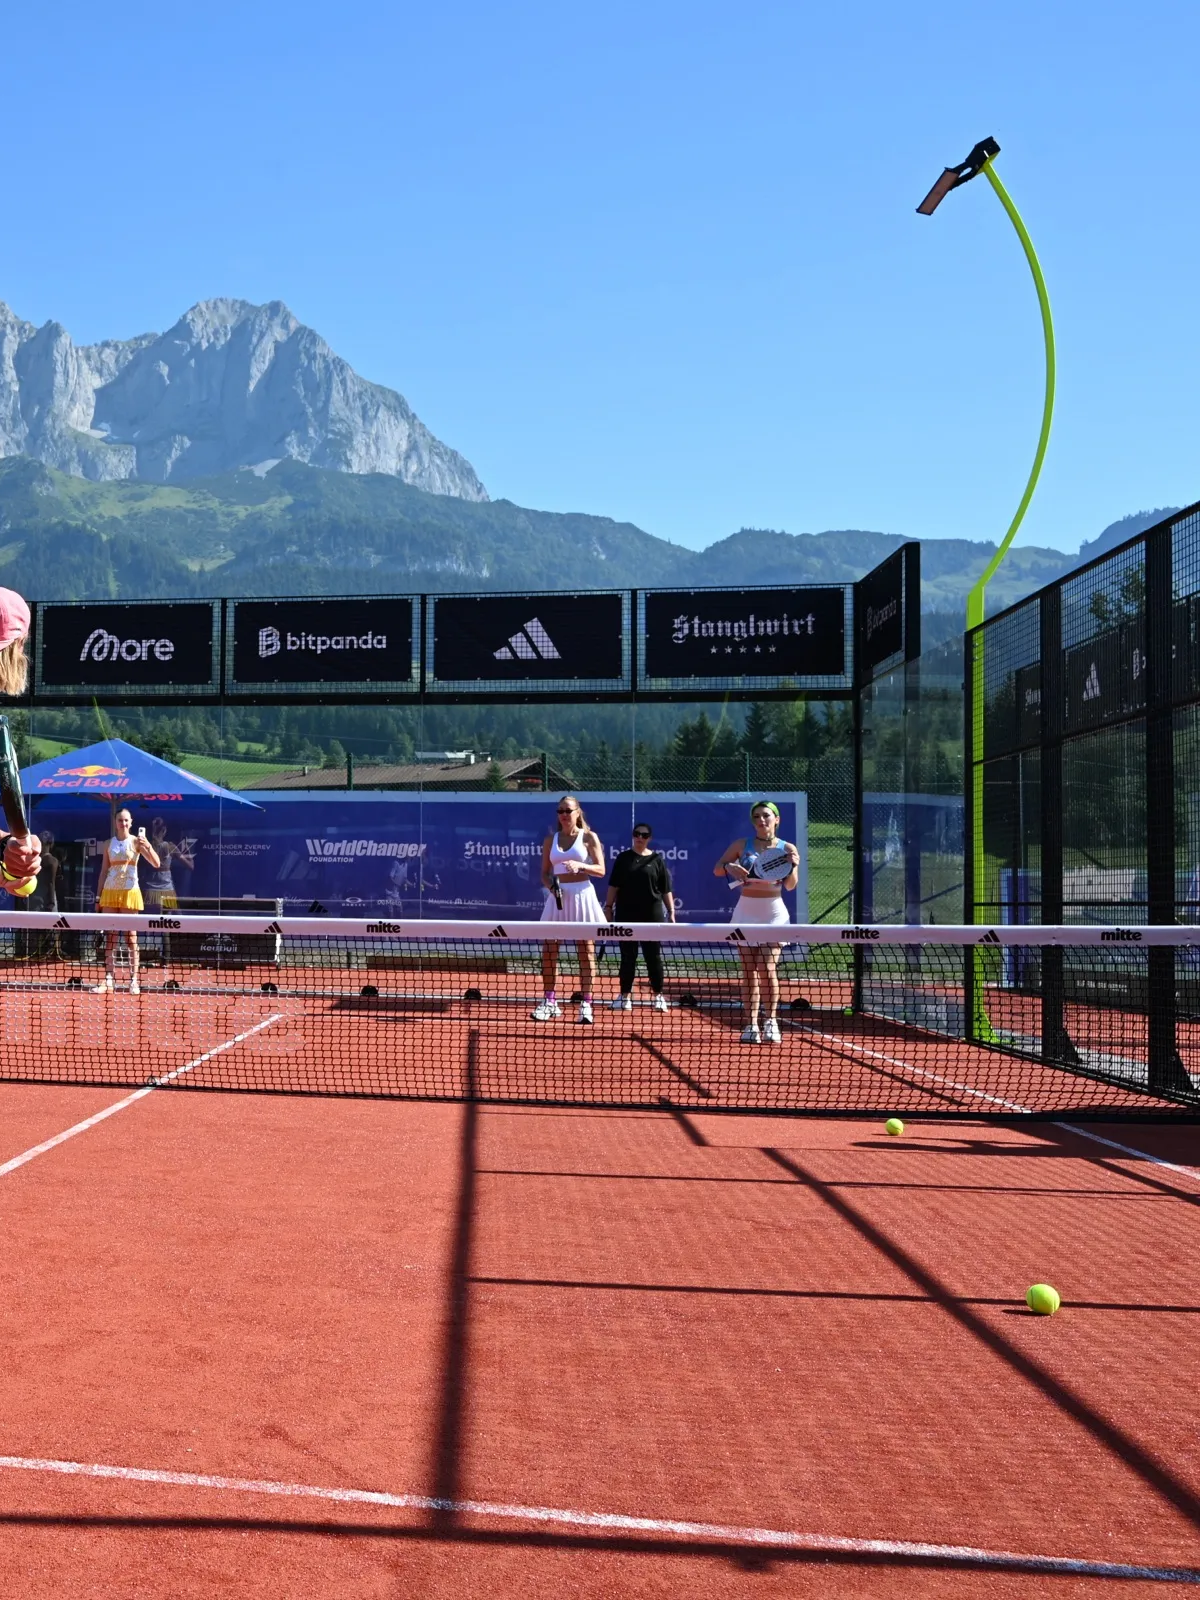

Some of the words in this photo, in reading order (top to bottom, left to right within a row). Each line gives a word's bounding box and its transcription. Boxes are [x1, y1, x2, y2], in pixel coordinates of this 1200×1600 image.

[672, 613, 816, 644] Stanglwirt
[79, 628, 175, 661] More
[287, 631, 387, 654] bitpanda
[37, 778, 83, 788] Red
[84, 777, 131, 788] Bull
[305, 838, 428, 858] WorldChanger
[464, 841, 544, 859] Stanglwir
[148, 917, 181, 929] mitte
[366, 920, 401, 934] mitte
[597, 924, 634, 937] mitte
[841, 926, 880, 940] mitte
[1100, 927, 1143, 942] mitte
